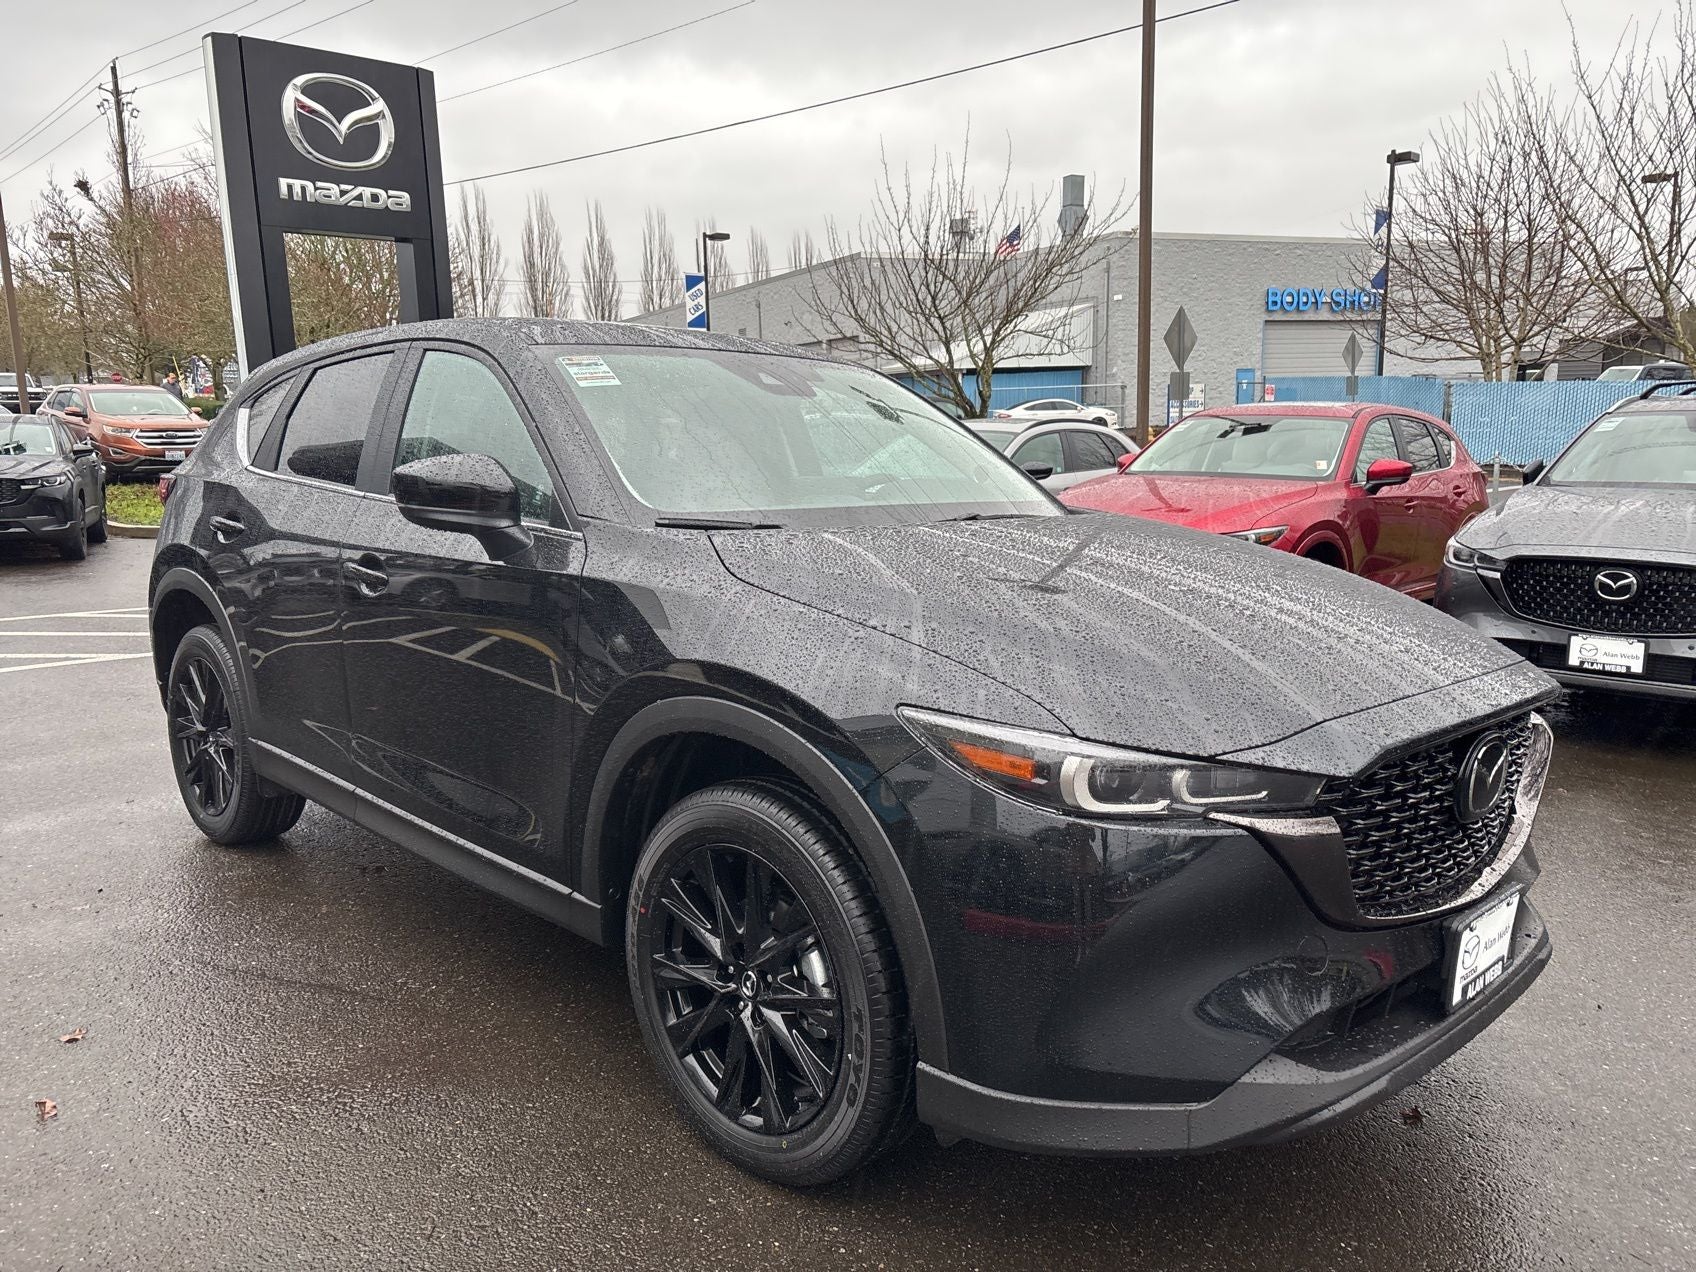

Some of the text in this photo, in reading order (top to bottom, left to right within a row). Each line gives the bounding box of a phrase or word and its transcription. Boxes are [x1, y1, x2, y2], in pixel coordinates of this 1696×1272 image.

[278, 177, 412, 212] mazda
[688, 288, 704, 302] USED
[1266, 287, 1326, 312] BODY
[688, 302, 704, 316] CARS
[1603, 651, 1641, 661] Alan Webb
[1583, 661, 1627, 673] ALAN WEBB
[1483, 937, 1497, 952] Alan
[1467, 960, 1503, 1000] ALAN WEBB
